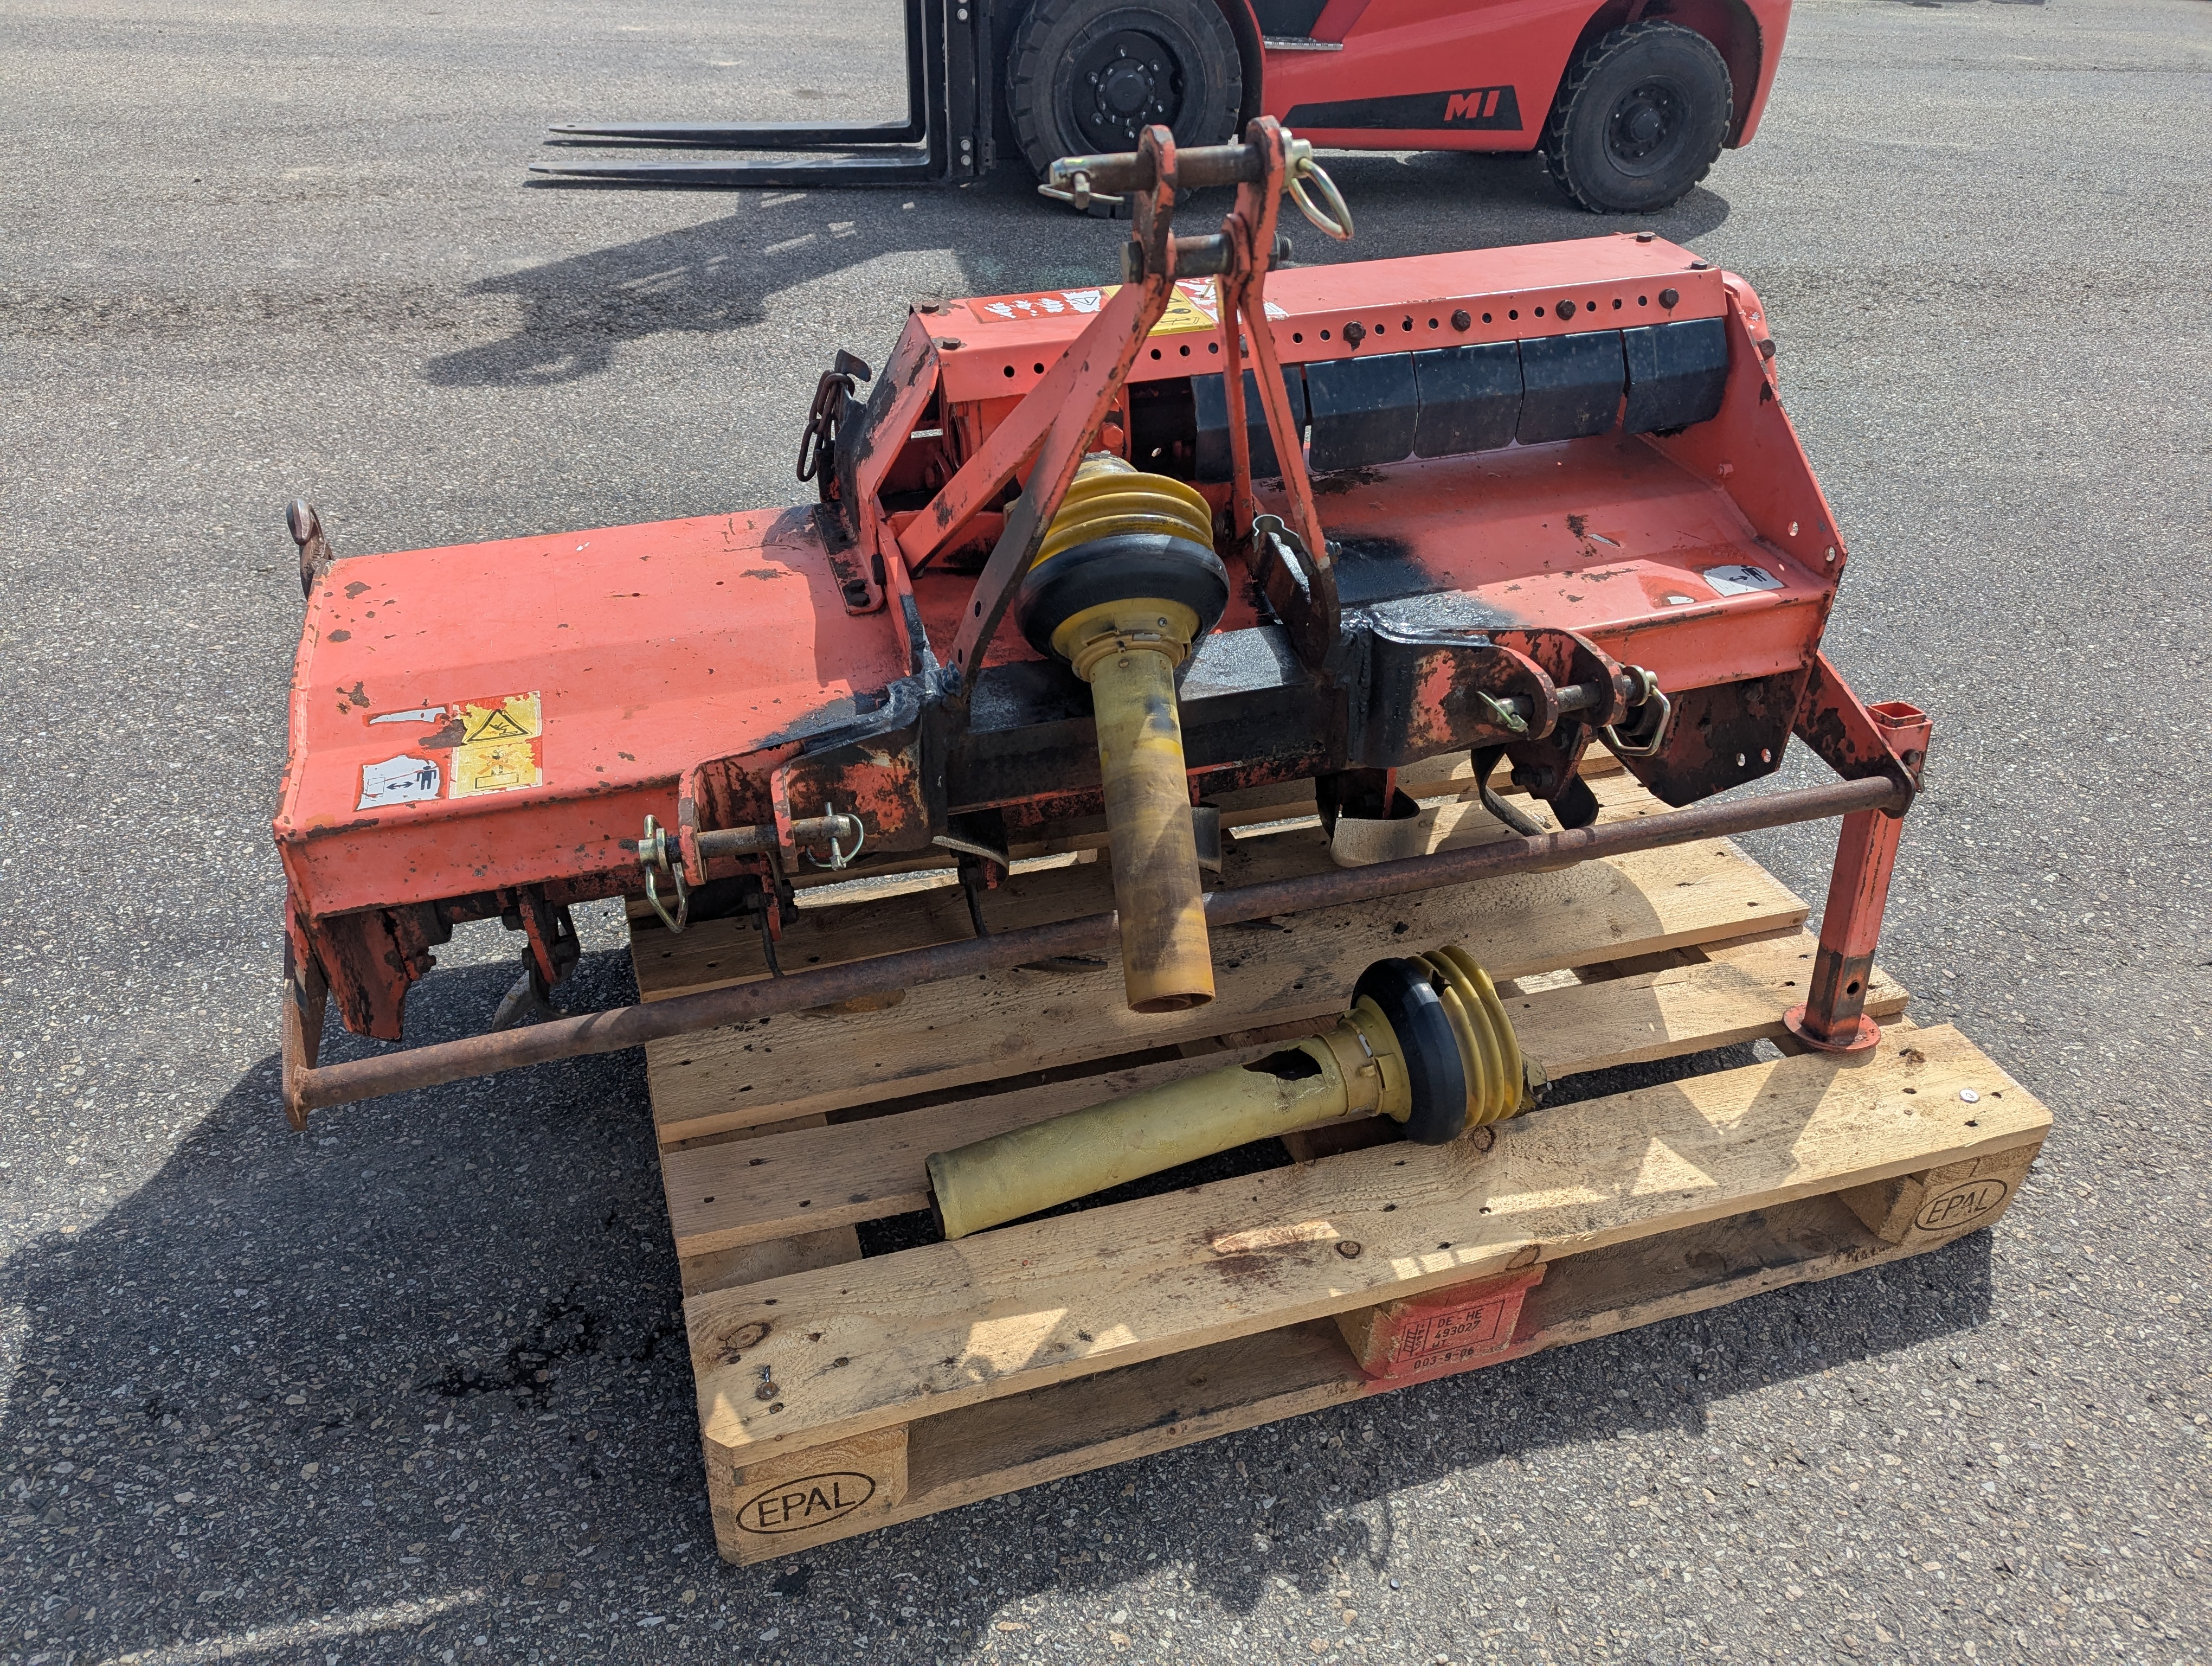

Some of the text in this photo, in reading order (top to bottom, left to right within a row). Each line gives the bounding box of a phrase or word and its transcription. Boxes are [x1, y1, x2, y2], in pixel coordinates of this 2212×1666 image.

[1444, 90, 1500, 121] MI
[1925, 1188, 1989, 1225] EPAL
[1434, 1319, 1481, 1339] 493027
[1413, 1347, 1475, 1369] 003-9-06
[757, 1482, 856, 1527] EPAL
